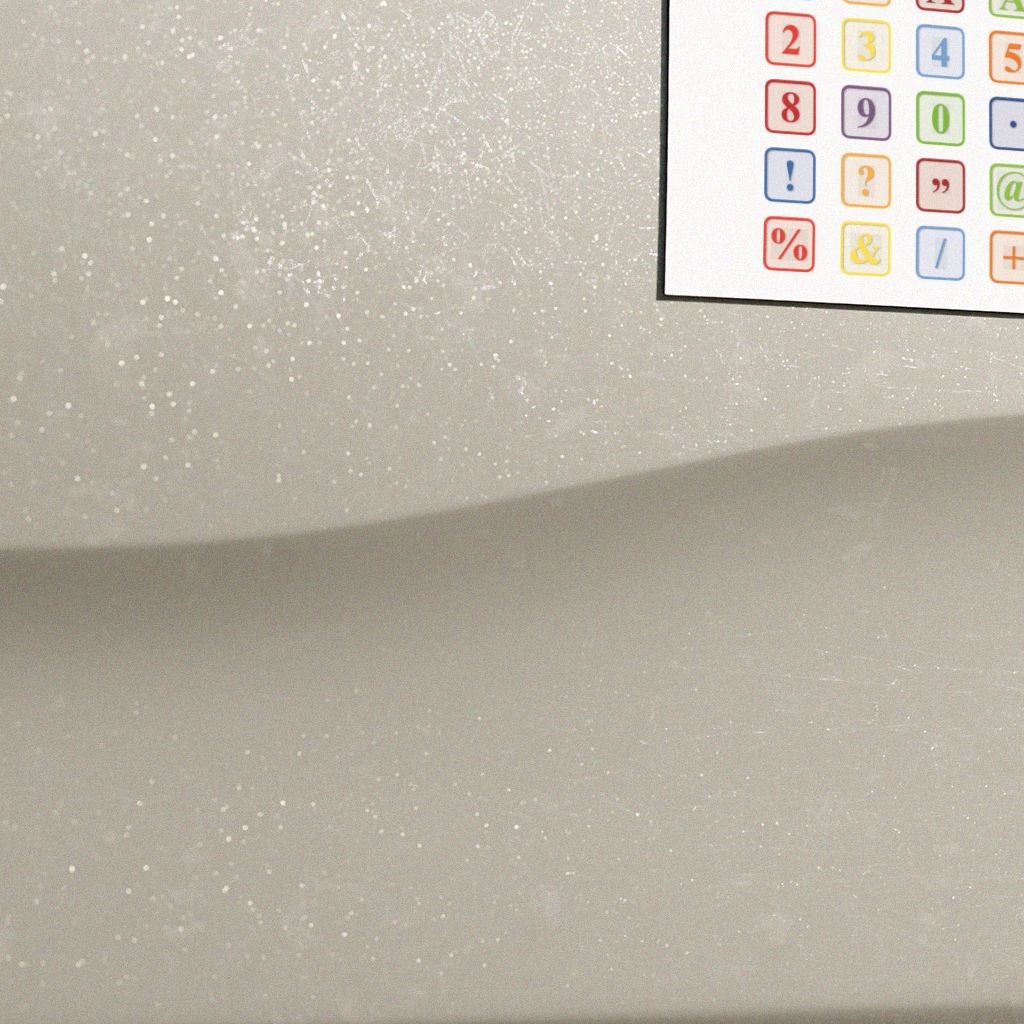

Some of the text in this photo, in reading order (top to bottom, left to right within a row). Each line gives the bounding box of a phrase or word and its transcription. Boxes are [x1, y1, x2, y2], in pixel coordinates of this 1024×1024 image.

[782, 24, 800, 55] 2
[858, 30, 876, 61] 3
[931, 38, 950, 68] 4
[1004, 43, 1022, 73] 5
[781, 92, 800, 123] 8
[857, 98, 876, 128] 9
[931, 104, 950, 134] 0
[786, 160, 794, 192] !
[858, 165, 875, 196] ?
[771, 228, 808, 261] %
[850, 234, 880, 265] &
[934, 238, 947, 269] /
[1003, 246, 1024, 270] +
